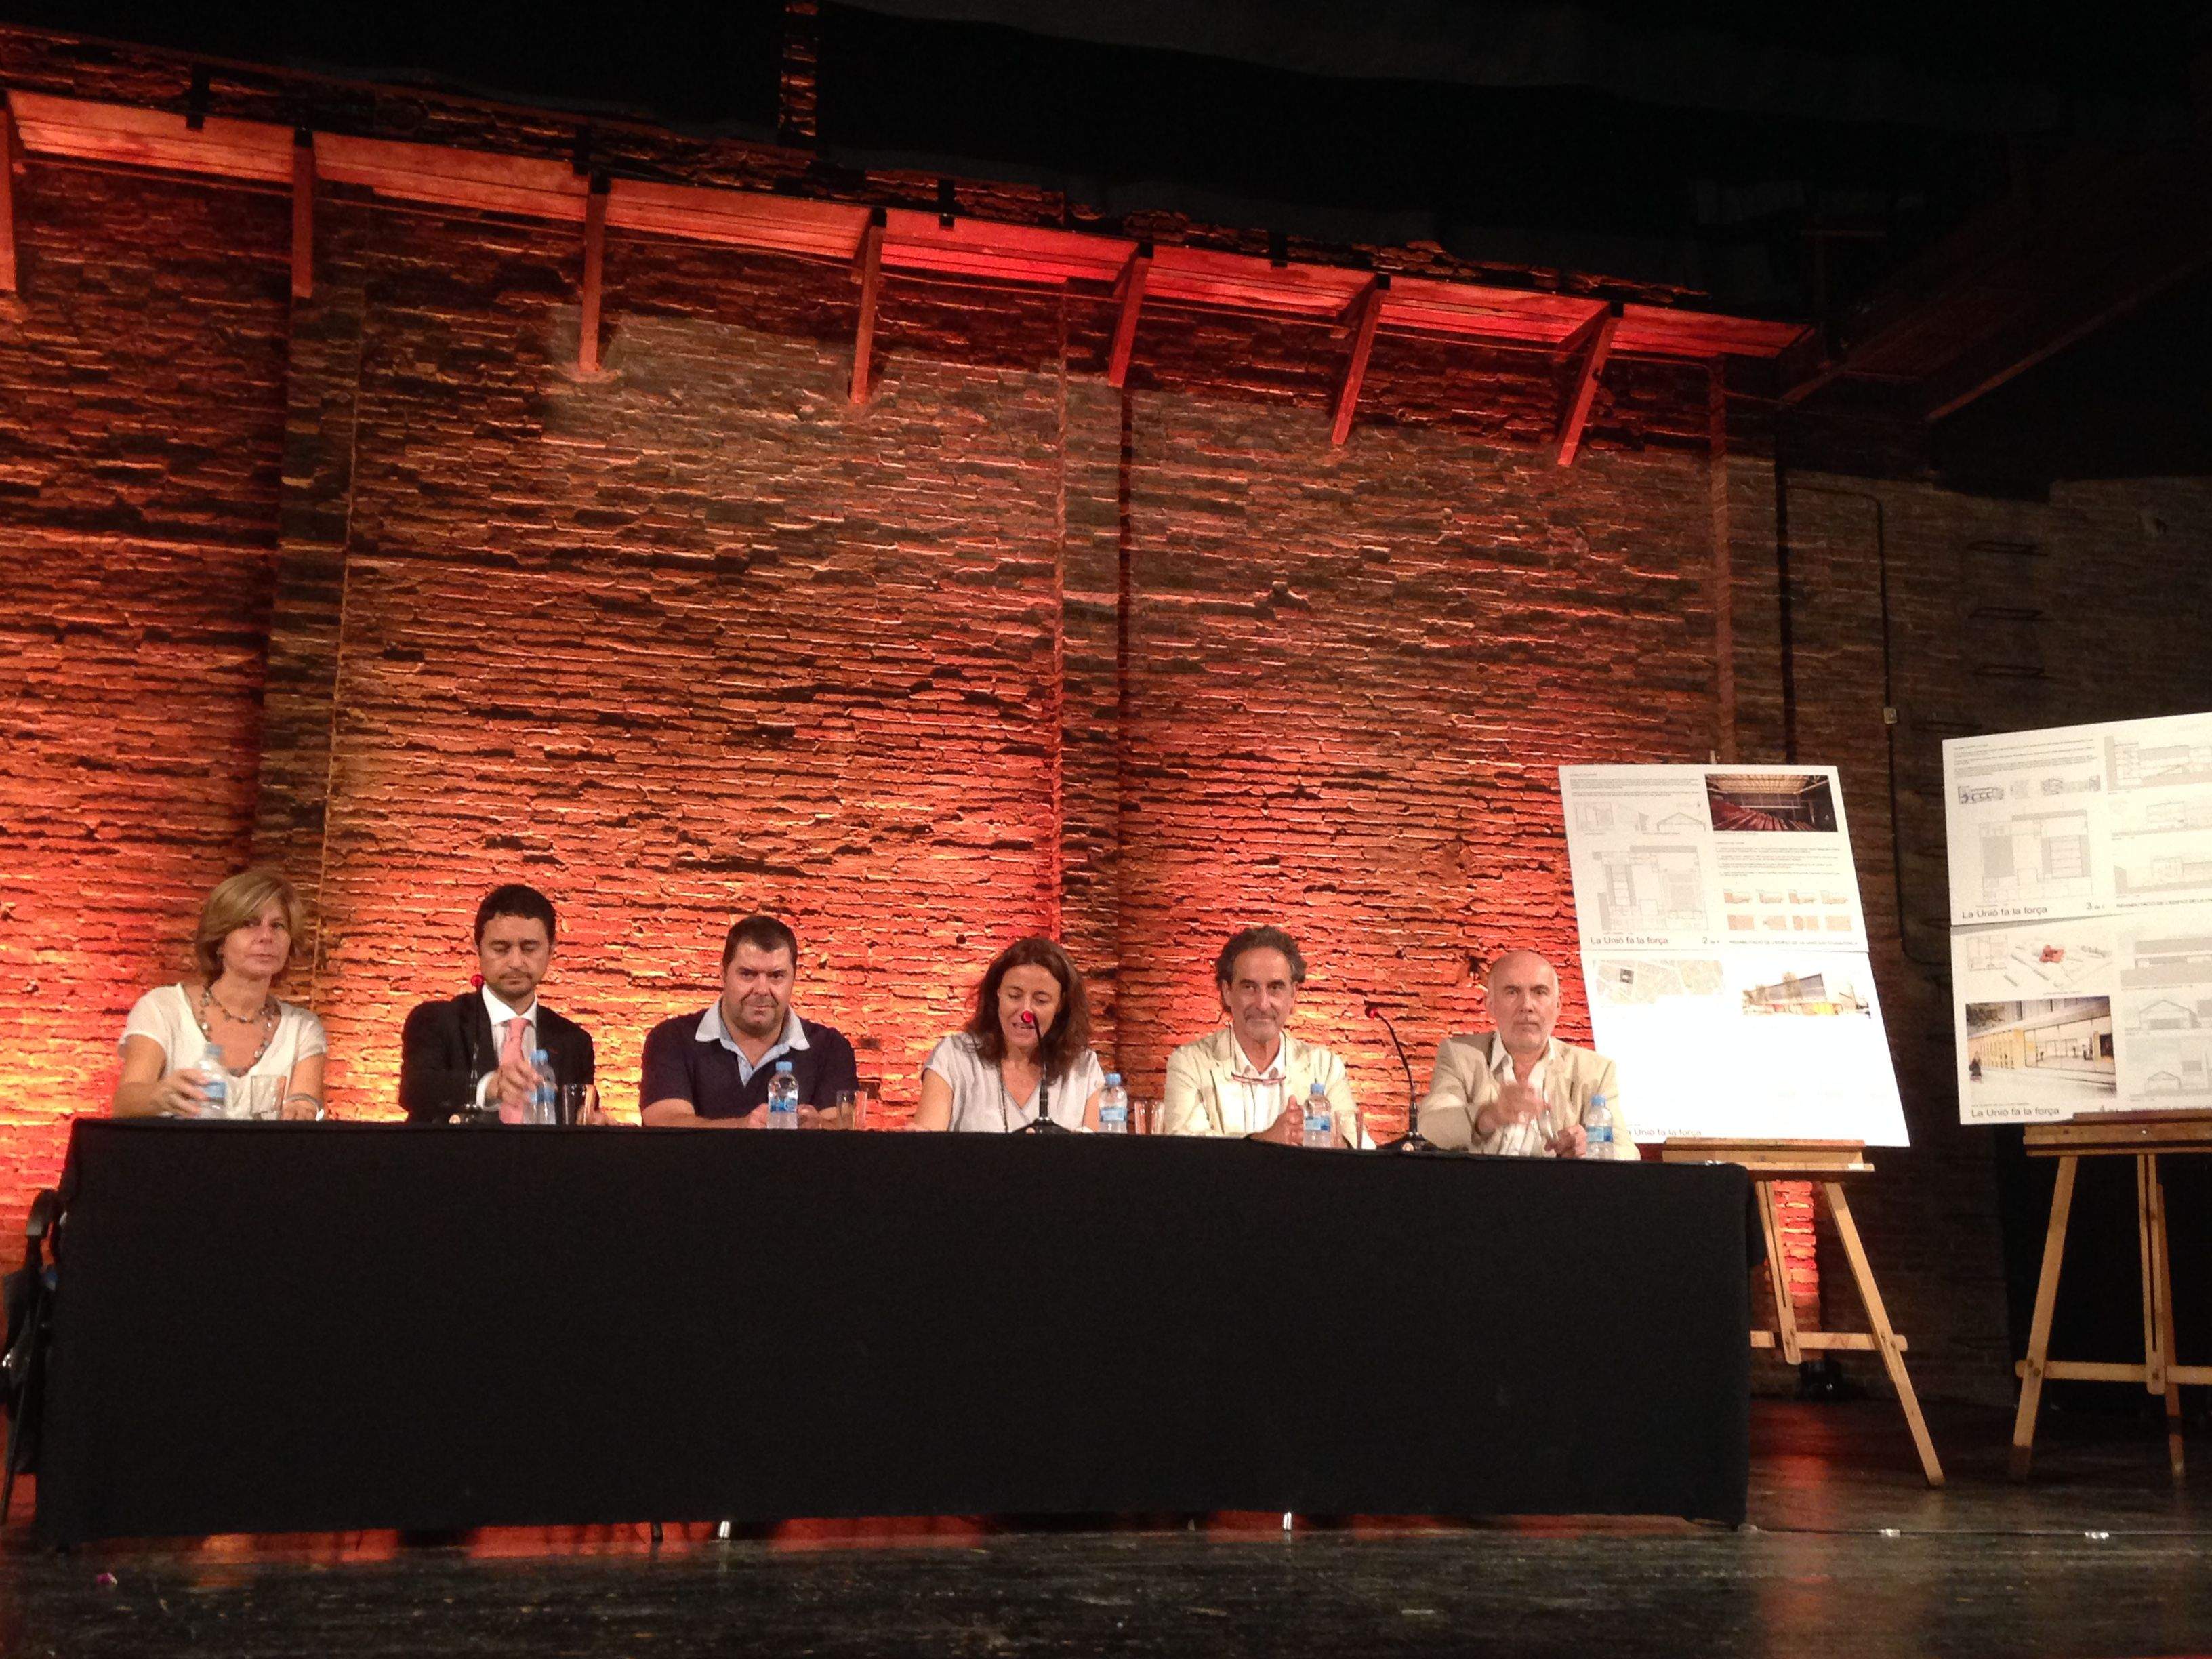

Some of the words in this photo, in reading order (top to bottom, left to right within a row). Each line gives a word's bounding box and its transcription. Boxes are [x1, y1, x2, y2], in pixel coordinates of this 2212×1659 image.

[2086, 902, 2093, 910] 3
[1963, 911, 1973, 919] La
[2001, 908, 2010, 916] fa
[2012, 907, 2021, 915] la
[2024, 905, 2047, 915] força
[1971, 1109, 1983, 1117] La
[2024, 1107, 2032, 1115] la
[2035, 1107, 2060, 1116] força
